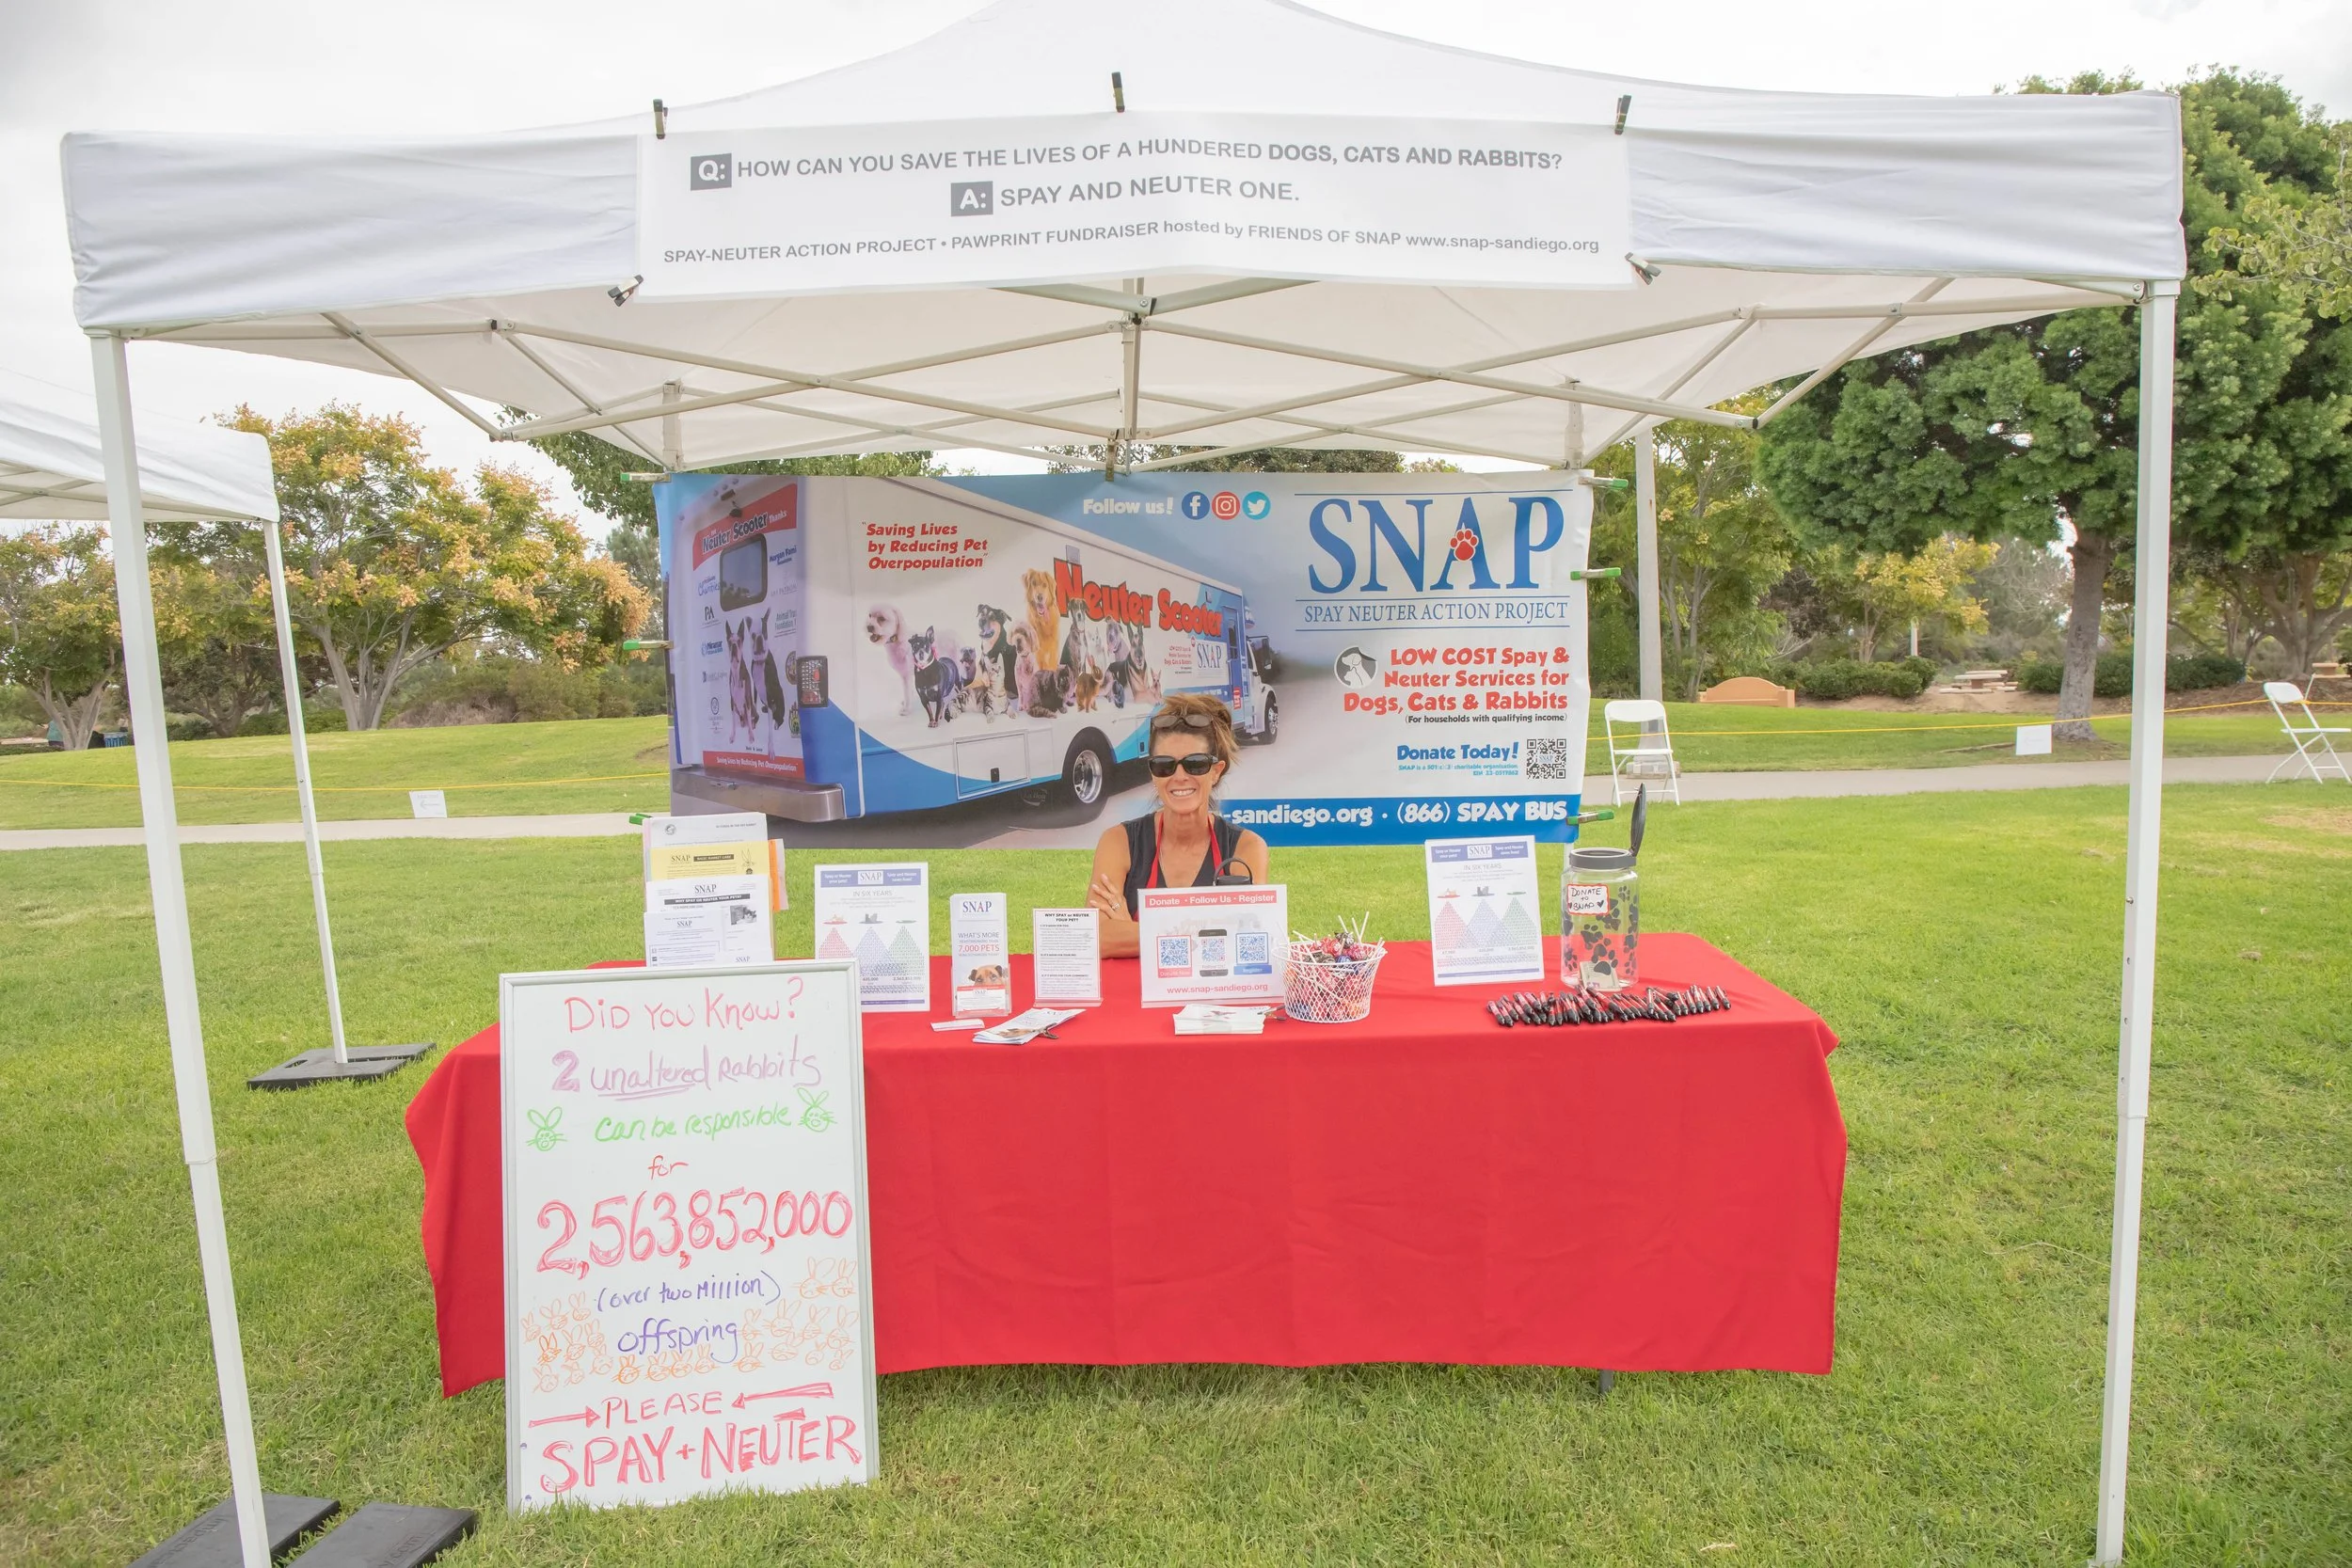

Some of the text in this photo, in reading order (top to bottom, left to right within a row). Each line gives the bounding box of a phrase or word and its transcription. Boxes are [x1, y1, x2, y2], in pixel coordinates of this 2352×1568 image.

[698, 138, 1563, 182] Q: HOW CAN YOU SAVE THE LIVES OF A HUNDERED DOGS, CATS AND RABBITS?
[959, 176, 1300, 211] A: SPAY AND NEUTER ONE.
[663, 218, 1599, 264] SPAY-NEUTER ACTION PROJECT PAWPRINT FUNDRAISER hosted by FRIENDS OF SNAP www.snap-sandiego.org
[1083, 498, 1174, 515] Follow us!
[733, 512, 768, 541] Scooter
[920, 523, 958, 535] Lives
[867, 538, 988, 555] by Reducing Pet
[1308, 496, 1565, 594] SNAP
[1053, 557, 1222, 637] Neuter Scooter
[1304, 601, 1568, 624] SPAY NEUTER ACTION PROJECT
[1197, 643, 1222, 669] SNAP
[1391, 646, 1570, 668] LOW COST Spay &
[1384, 669, 1570, 689] Neuter Services for
[1343, 690, 1568, 716] Dogs, Cats & Rabbits
[1405, 713, 1567, 725] (For households with qualifying income)
[1397, 741, 1519, 762] Donate Today!
[1396, 801, 1451, 825] (866)
[1457, 802, 1520, 822] SPAY
[1524, 801, 1567, 820] BUS
[1469, 846, 1490, 855] SNAP
[859, 872, 882, 881] SNAP
[694, 884, 717, 894] SNAP
[1149, 894, 1275, 906] Donate Follow Us Register
[1571, 888, 1601, 896] DONATE
[962, 901, 992, 913] SNAP
[958, 943, 1000, 953] 7,000 PETS
[1167, 984, 1268, 994] www.snap-sandiego.org
[551, 1035, 821, 1094] 2 unaltered Rabbits
[685, 1101, 792, 1141] responsible
[648, 1154, 689, 1180] for
[536, 1187, 853, 1280] 2,563,852,000
[617, 1317, 739, 1364] offspring
[601, 1391, 723, 1429] PLEASE
[540, 1425, 675, 1494] SPAY
[700, 1407, 863, 1480] NEUTER
